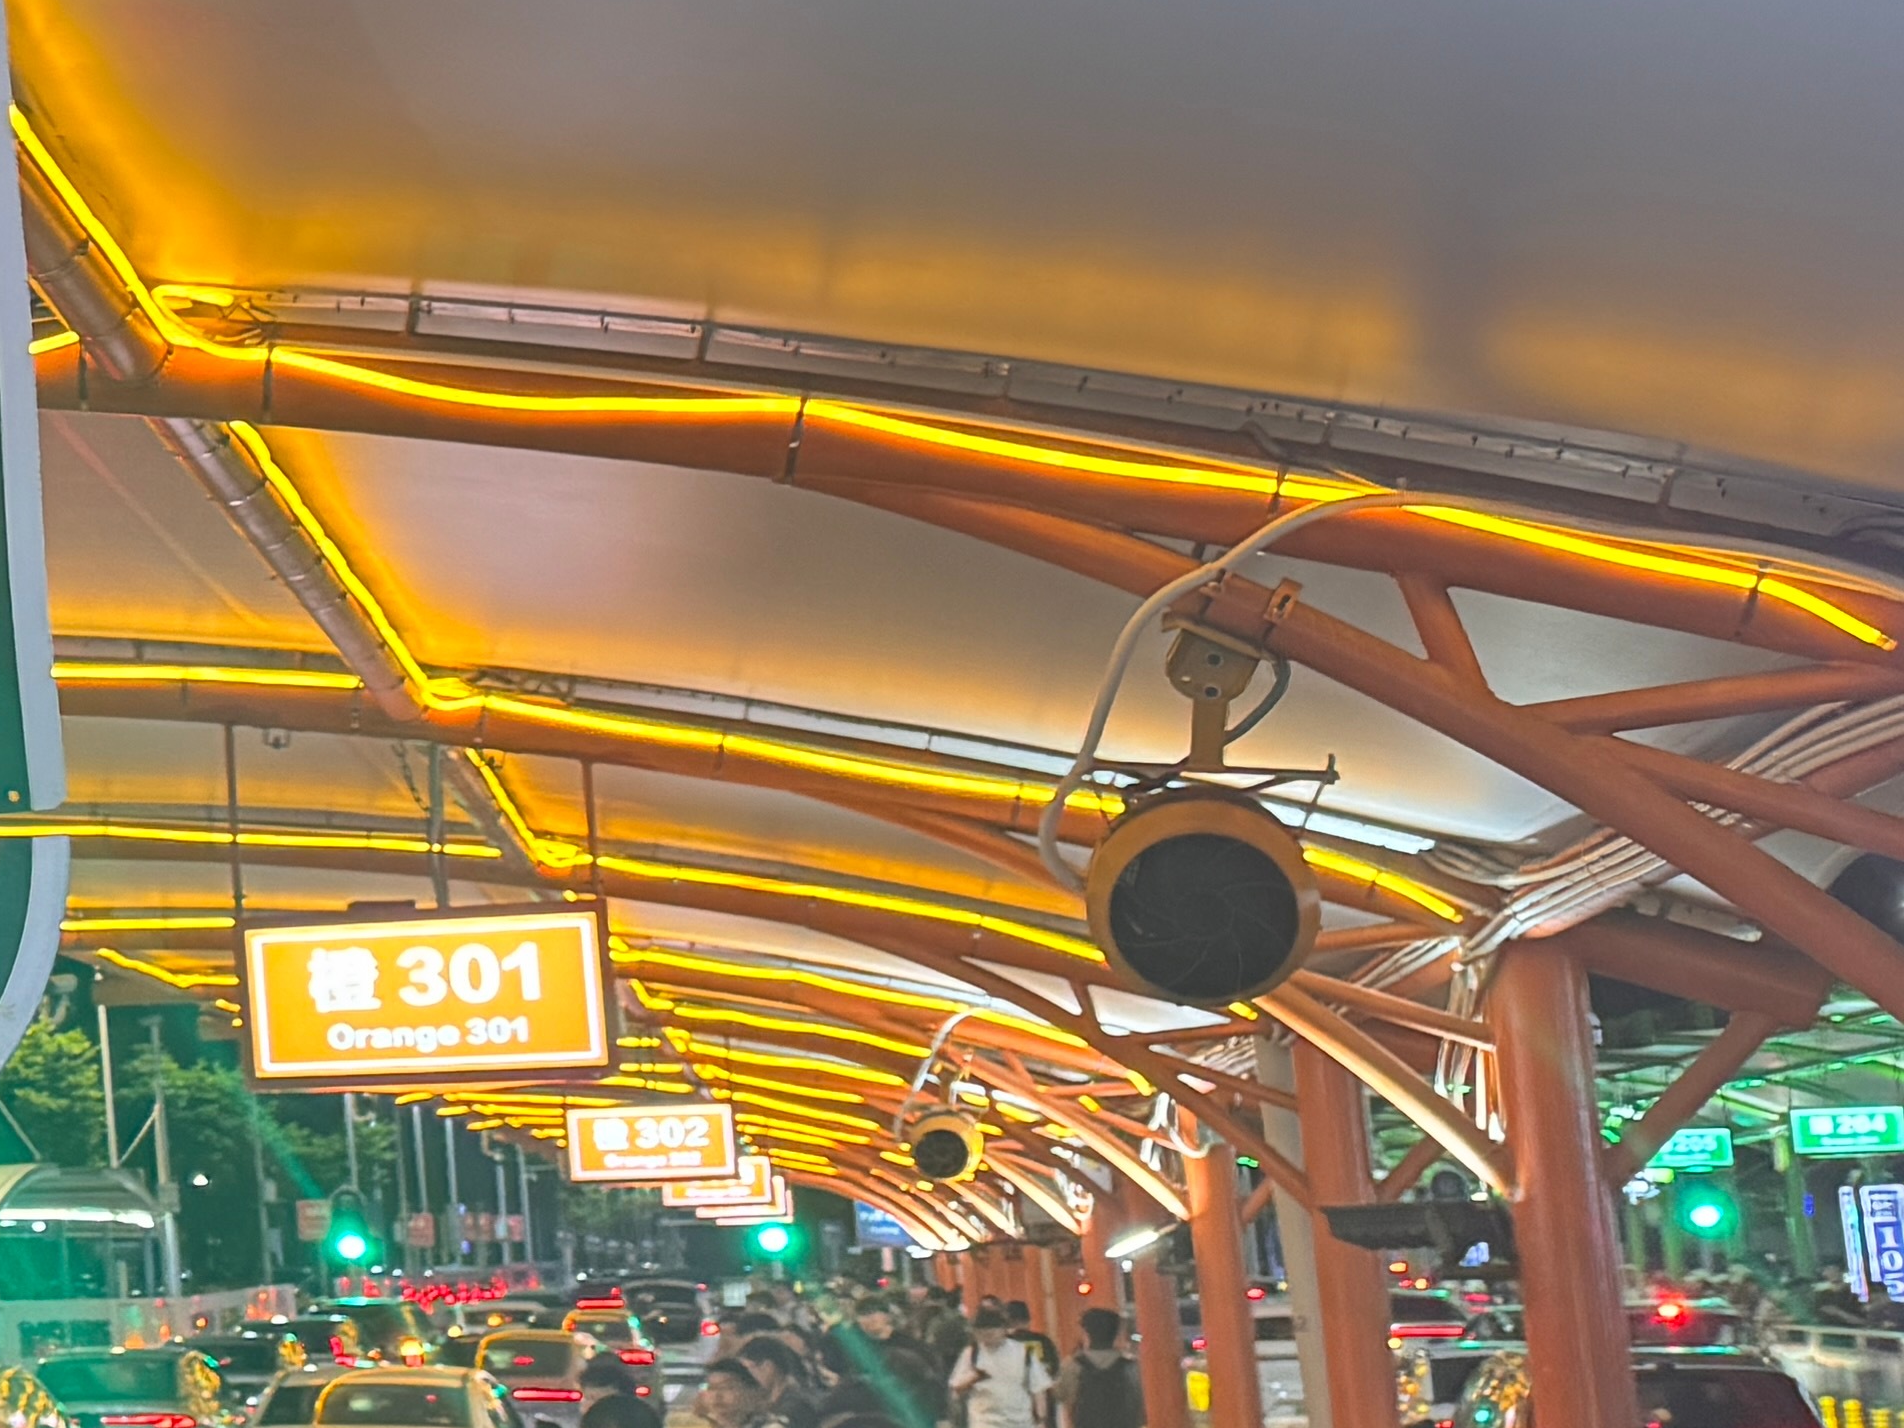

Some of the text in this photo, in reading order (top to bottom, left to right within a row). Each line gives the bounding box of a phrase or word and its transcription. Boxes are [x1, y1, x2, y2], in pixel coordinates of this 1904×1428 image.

[396, 941, 542, 1007] 301
[327, 1016, 529, 1053] Orange 301
[634, 1115, 710, 1149] 302
